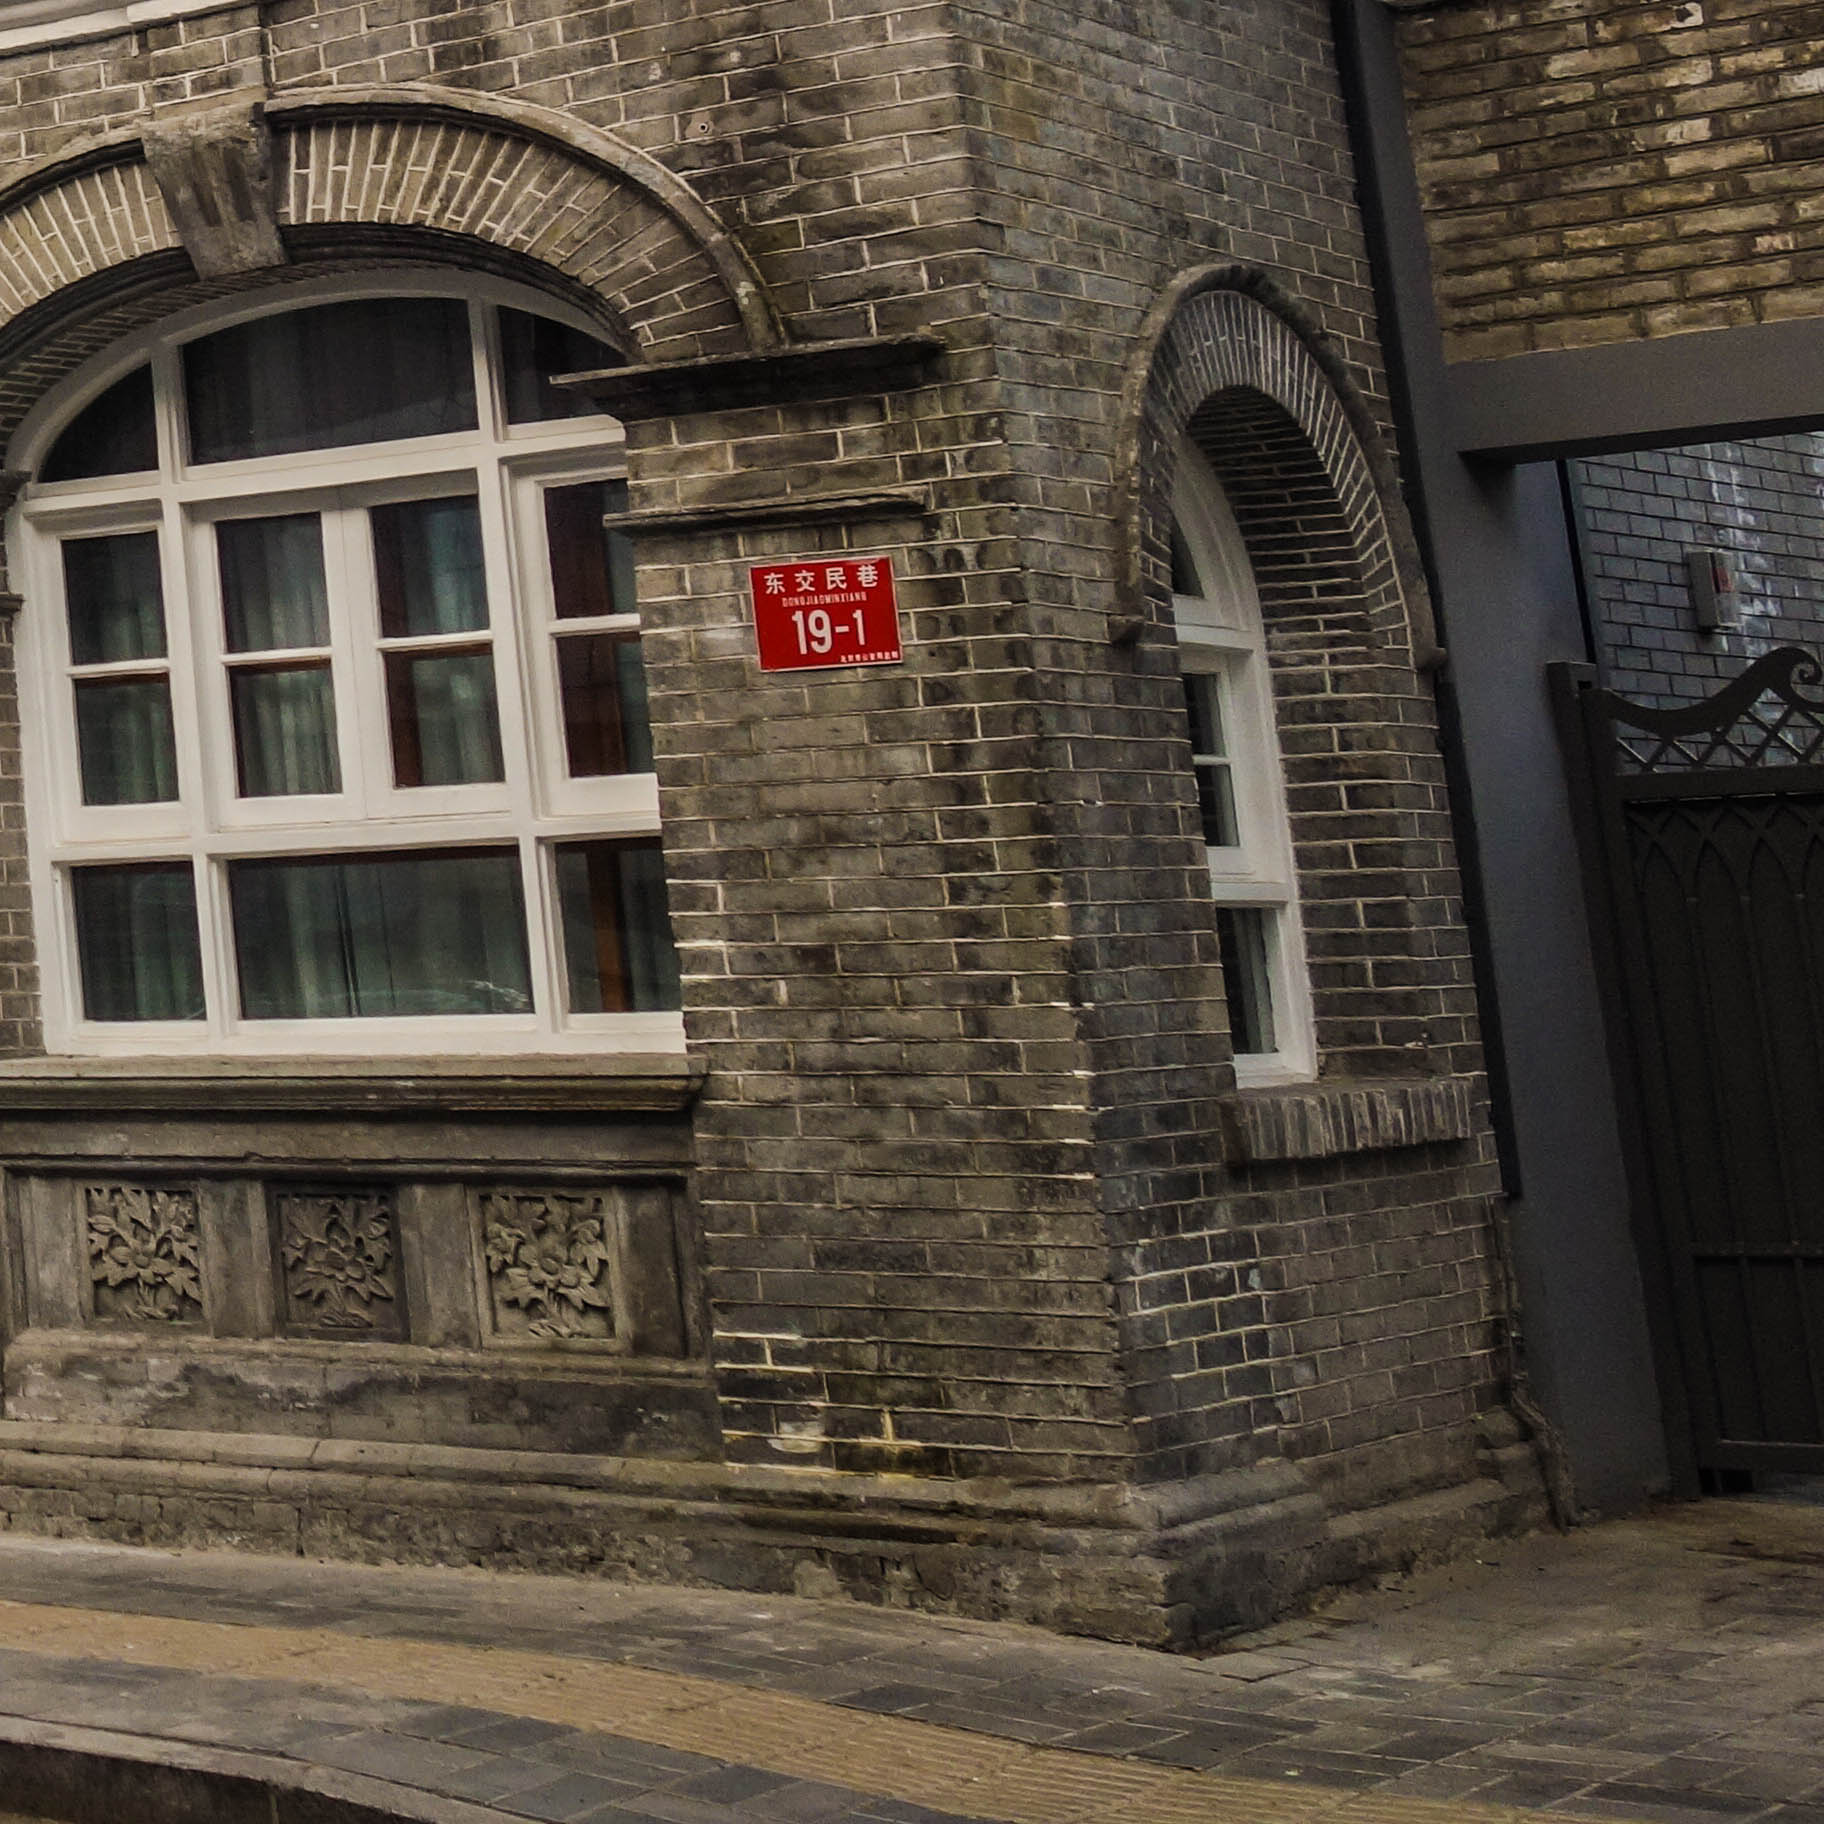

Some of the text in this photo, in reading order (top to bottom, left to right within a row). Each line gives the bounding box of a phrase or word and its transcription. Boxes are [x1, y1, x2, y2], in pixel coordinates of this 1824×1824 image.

[763, 564, 879, 595] 东交民巷
[782, 591, 867, 607] DONGJIAOMINXIANG
[791, 609, 866, 655] 19-1
